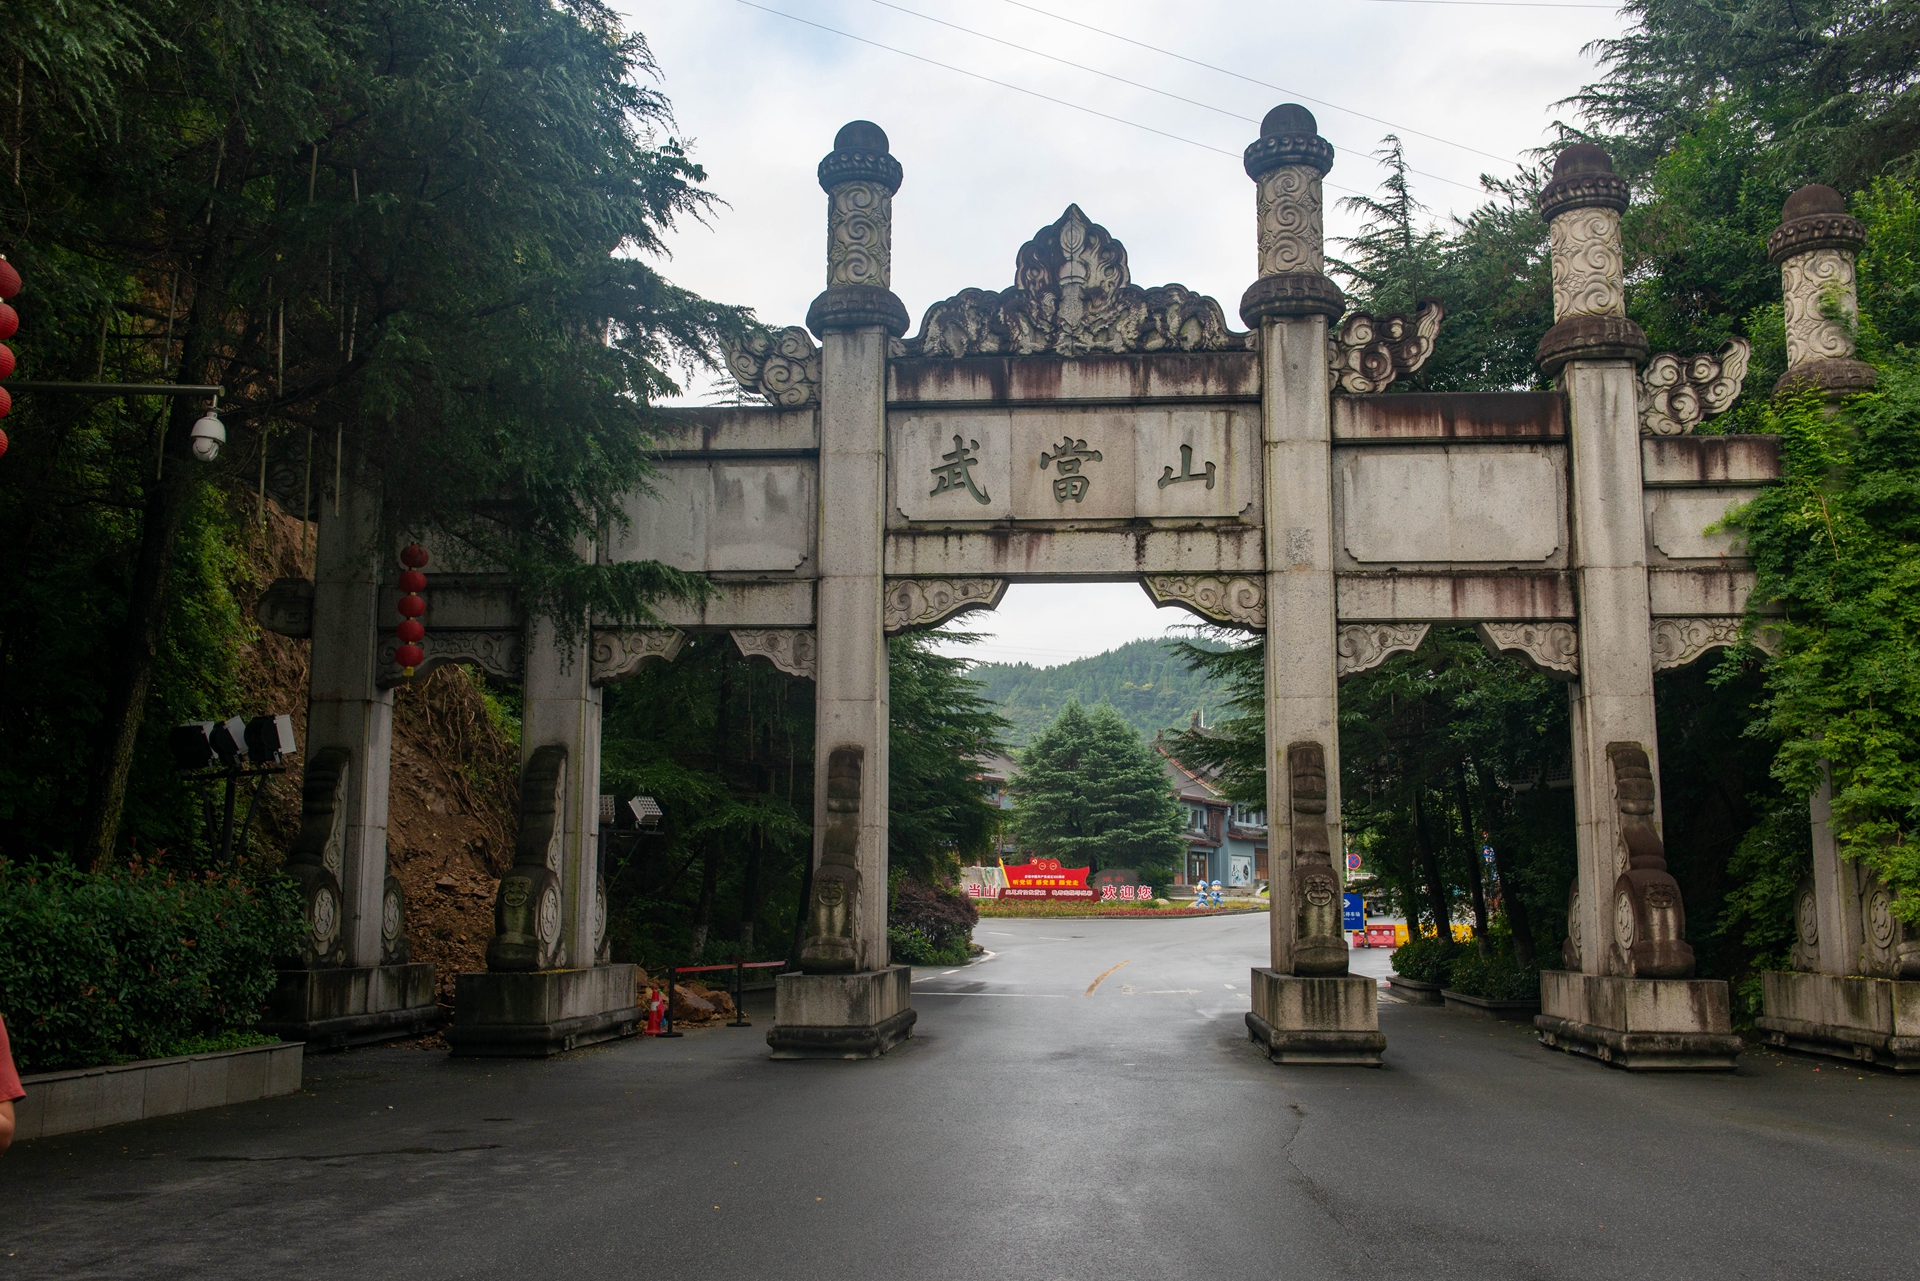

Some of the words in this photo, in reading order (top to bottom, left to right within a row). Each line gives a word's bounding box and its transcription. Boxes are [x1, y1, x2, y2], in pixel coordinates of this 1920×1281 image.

[930, 433, 1217, 505] 武當山
[959, 882, 996, 899] 当山
[1101, 884, 1153, 901] 欢迎您
